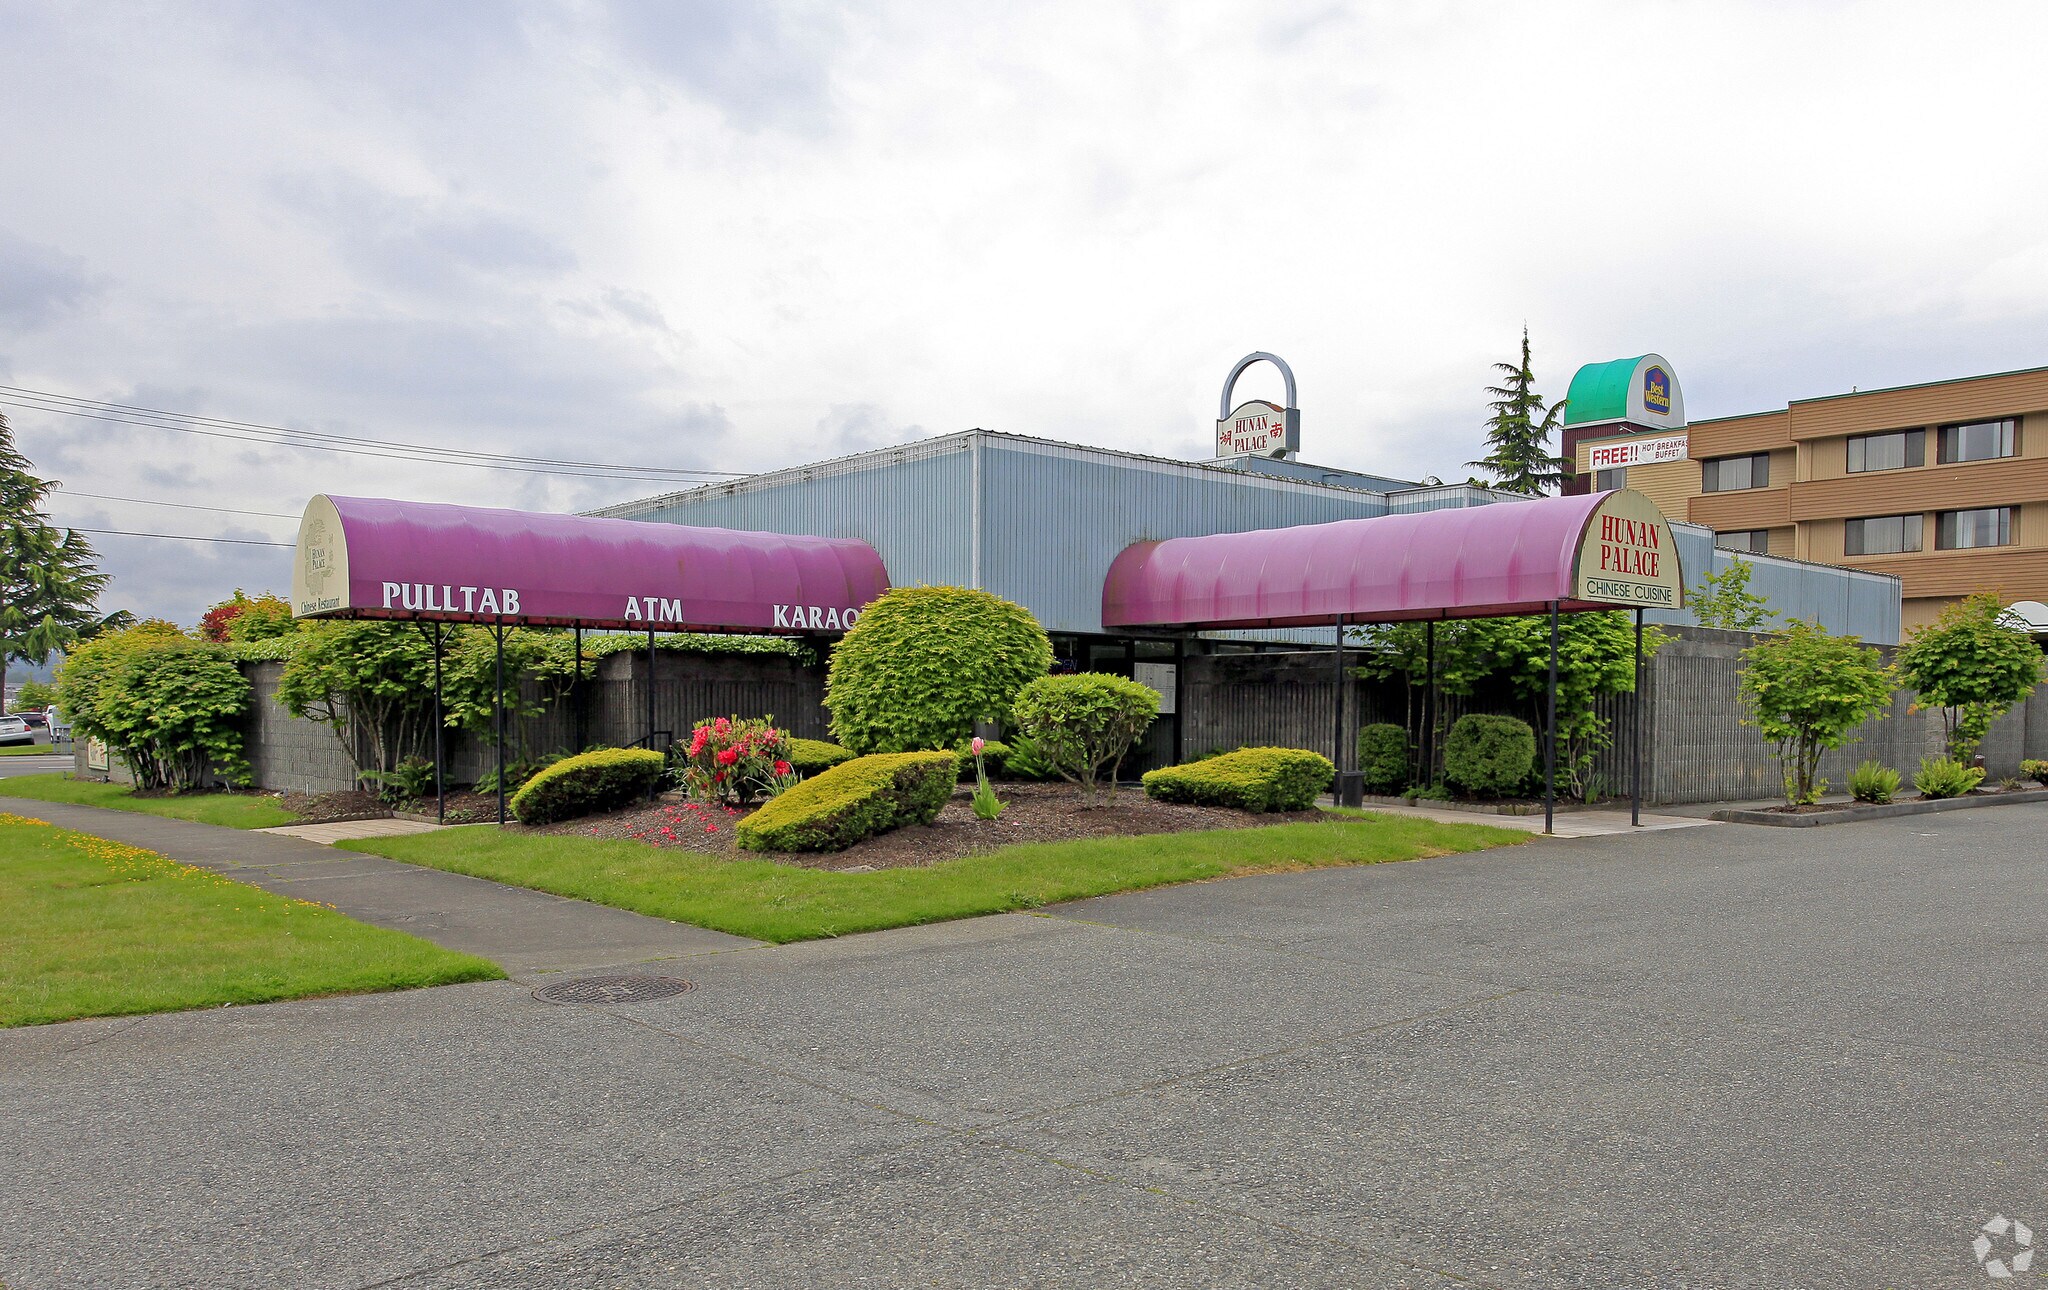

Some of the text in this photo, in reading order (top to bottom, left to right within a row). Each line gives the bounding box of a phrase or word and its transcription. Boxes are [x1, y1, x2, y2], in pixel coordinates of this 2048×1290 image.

[1651, 381, 1664, 396] Best
[1645, 390, 1669, 407] Western
[1235, 416, 1268, 434] HUNAN
[1269, 422, 1283, 438] 南
[1234, 435, 1268, 452] PALACE
[1642, 443, 1655, 452] HOT
[1593, 445, 1638, 466] FREE!!
[1655, 449, 1679, 459] BUFFET
[1600, 514, 1660, 549] HUNAN
[1600, 544, 1660, 577] PALACE
[382, 581, 521, 615] PULLTAB
[1587, 580, 1672, 602] CHINESE CUISINE
[301, 601, 317, 614] Chinese
[624, 596, 684, 623] ATM
[773, 604, 864, 630] KARAO
